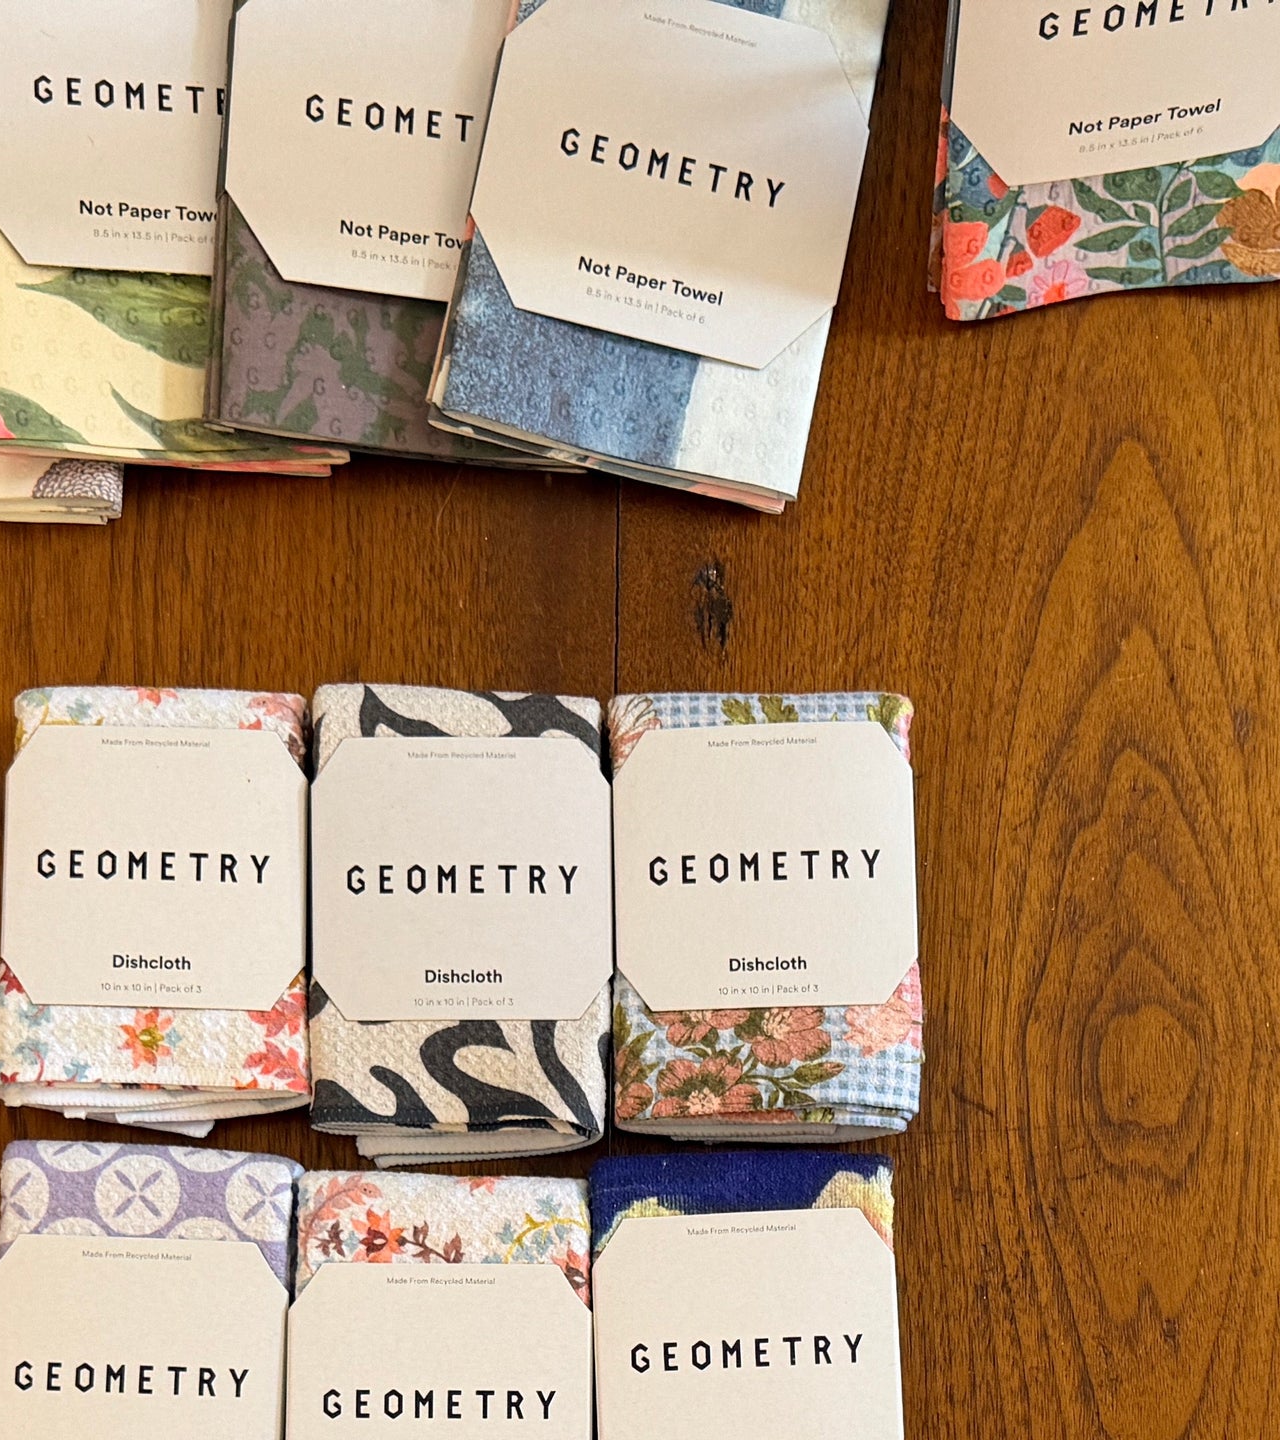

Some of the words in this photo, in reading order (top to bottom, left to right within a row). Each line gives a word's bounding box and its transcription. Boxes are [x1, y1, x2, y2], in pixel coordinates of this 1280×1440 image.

[1068, 120, 1103, 135] Not
[1108, 112, 1162, 130] Paper
[1167, 98, 1221, 120] Towel
[560, 127, 785, 207] GEOMETRY
[79, 199, 113, 216] Not
[118, 202, 171, 222] Paper
[340, 219, 372, 238] Not
[378, 224, 430, 245] Paper
[578, 255, 611, 277] Not
[615, 265, 667, 290] Paper
[672, 279, 723, 306] Towel
[37, 848, 270, 884] GEOMETRY
[346, 864, 578, 895] GEOMETRY
[649, 849, 880, 886] GEOMETRY
[112, 954, 191, 970] Dishcloth
[425, 969, 502, 983] Dishcloth
[729, 955, 807, 972] Dishcloth
[718, 986, 729, 996] 10
[730, 986, 739, 994] in
[748, 985, 760, 995] 10
[761, 985, 770, 994] in
[776, 984, 799, 994] Pack
[800, 983, 811, 993] of
[812, 983, 819, 993] 3
[630, 1333, 863, 1373] GEOMETRY
[14, 1360, 249, 1397] GEOMETRY
[323, 1388, 556, 1419] GEOMETRY
